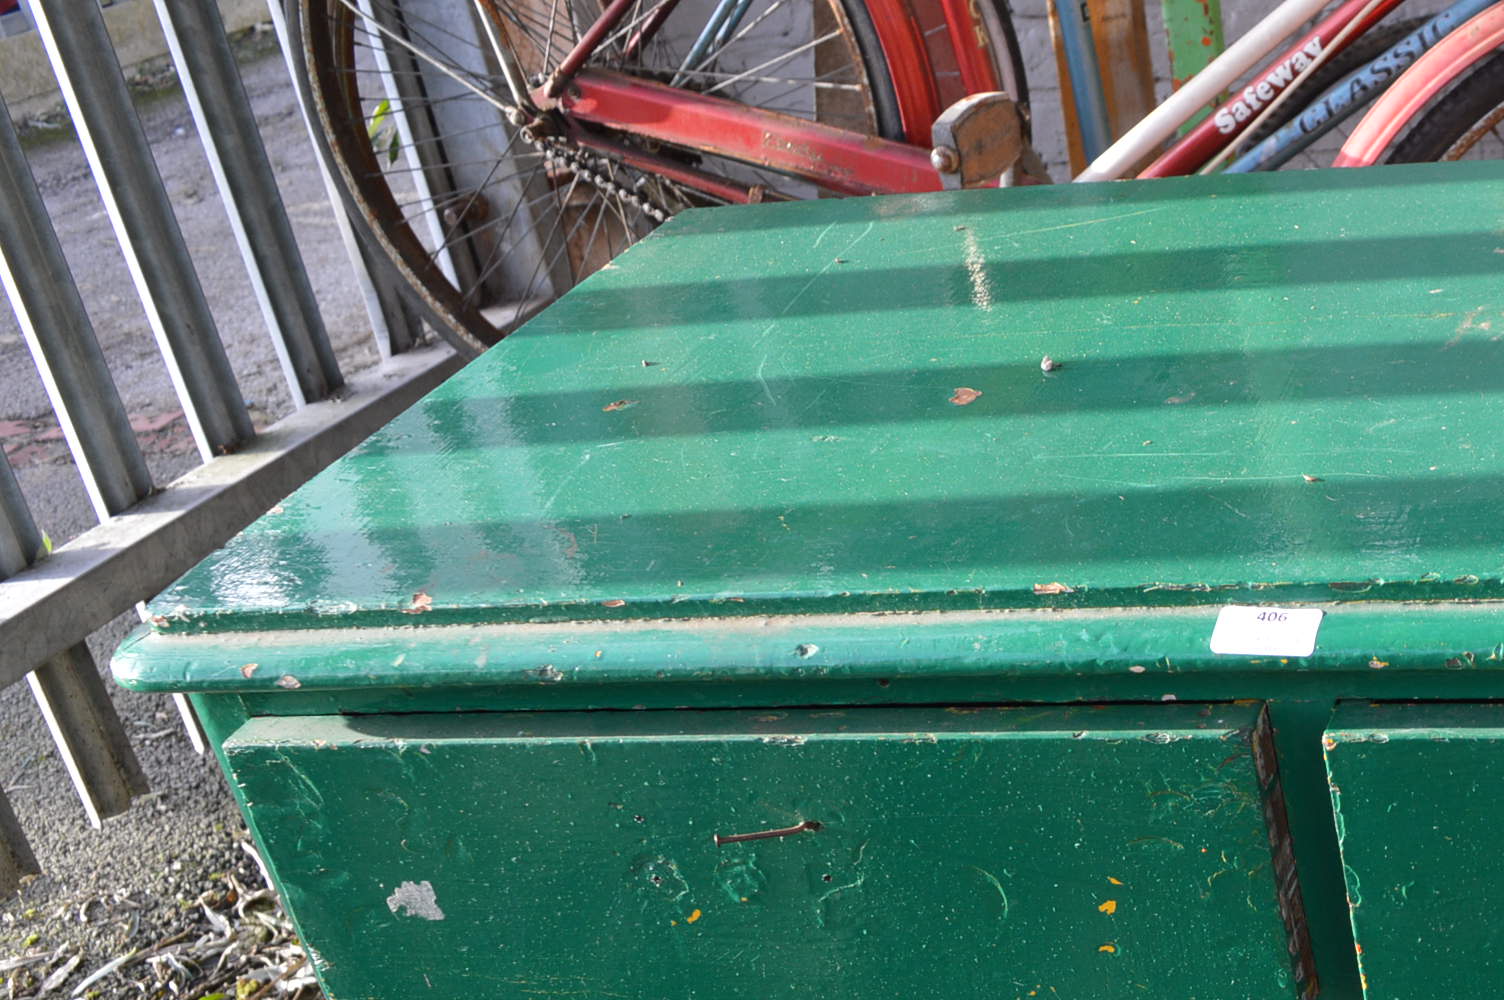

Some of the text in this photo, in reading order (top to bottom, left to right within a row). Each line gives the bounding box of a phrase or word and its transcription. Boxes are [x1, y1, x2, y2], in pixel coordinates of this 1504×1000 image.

[1214, 36, 1323, 134] Safeway
[1299, 13, 1456, 133] CLASSIC
[1256, 611, 1289, 622] 406
